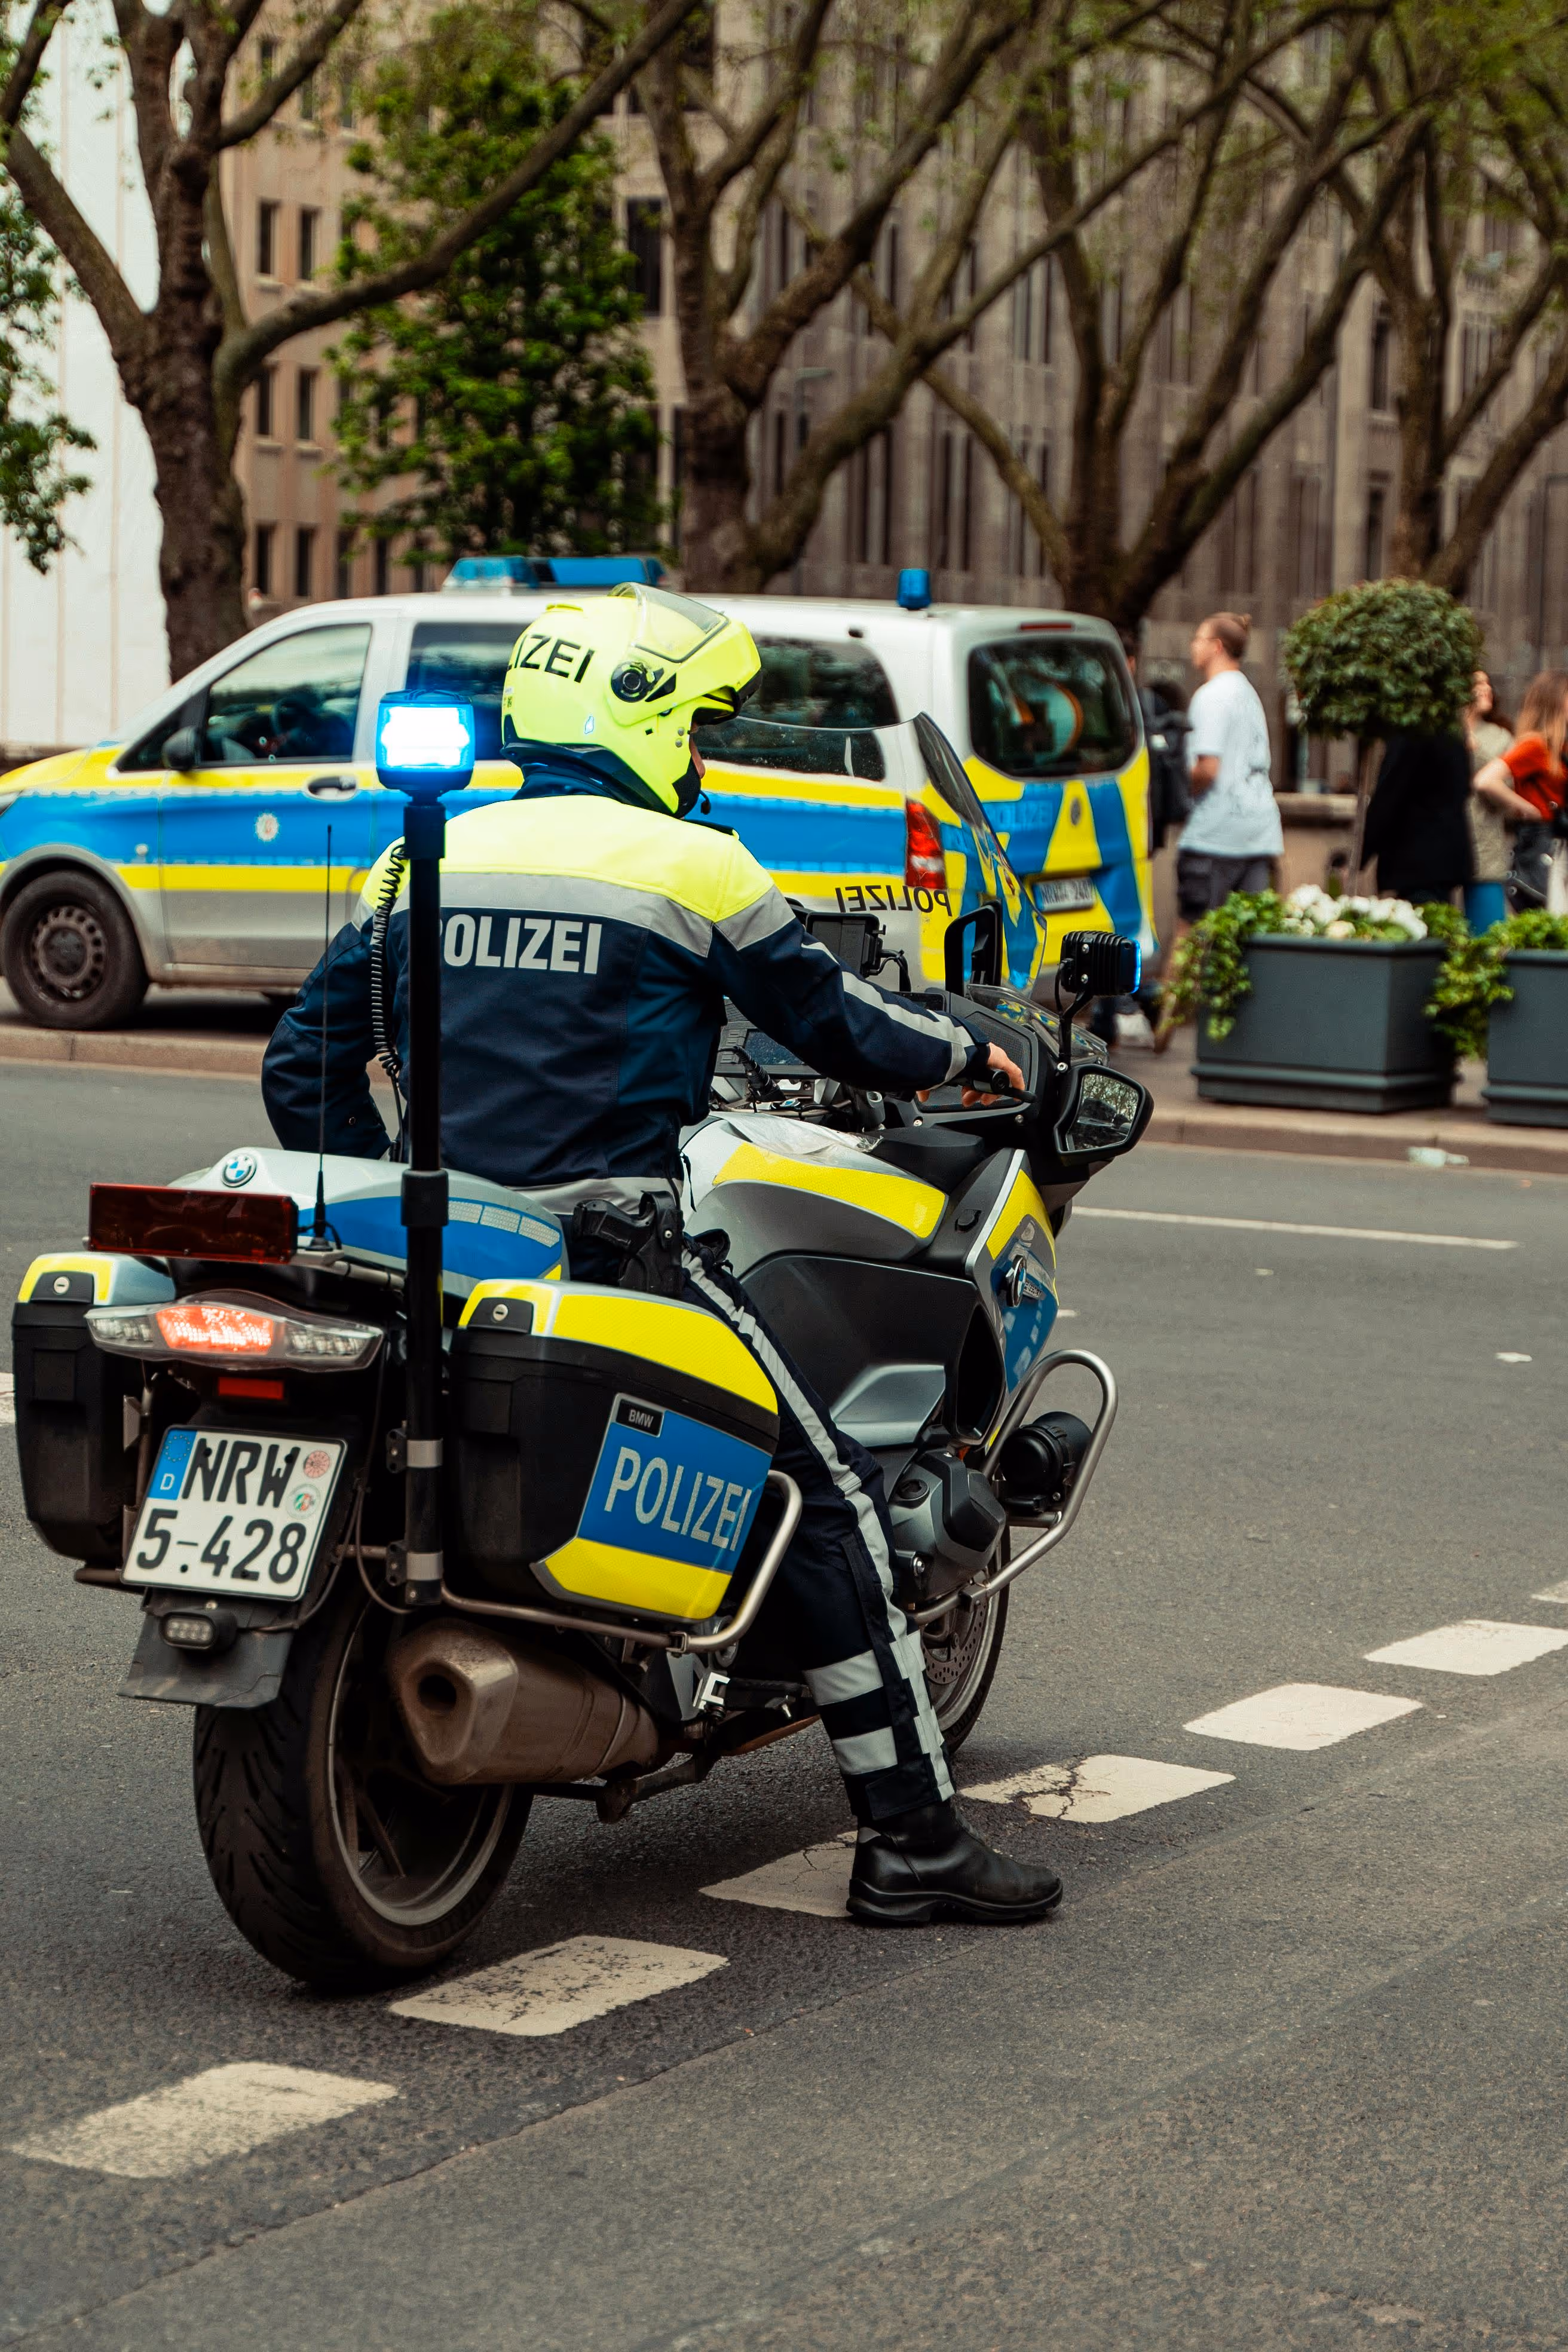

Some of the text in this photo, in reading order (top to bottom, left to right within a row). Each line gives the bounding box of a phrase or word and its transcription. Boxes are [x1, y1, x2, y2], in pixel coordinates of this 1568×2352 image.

[507, 633, 595, 684] IZEI
[439, 913, 603, 975] OLIZEI
[629, 1408, 654, 1428] BMW
[160, 1472, 176, 1491] D
[181, 1437, 301, 1508] NRW
[604, 1446, 752, 1552] POLIZEI
[136, 1508, 307, 1584] 5-428
